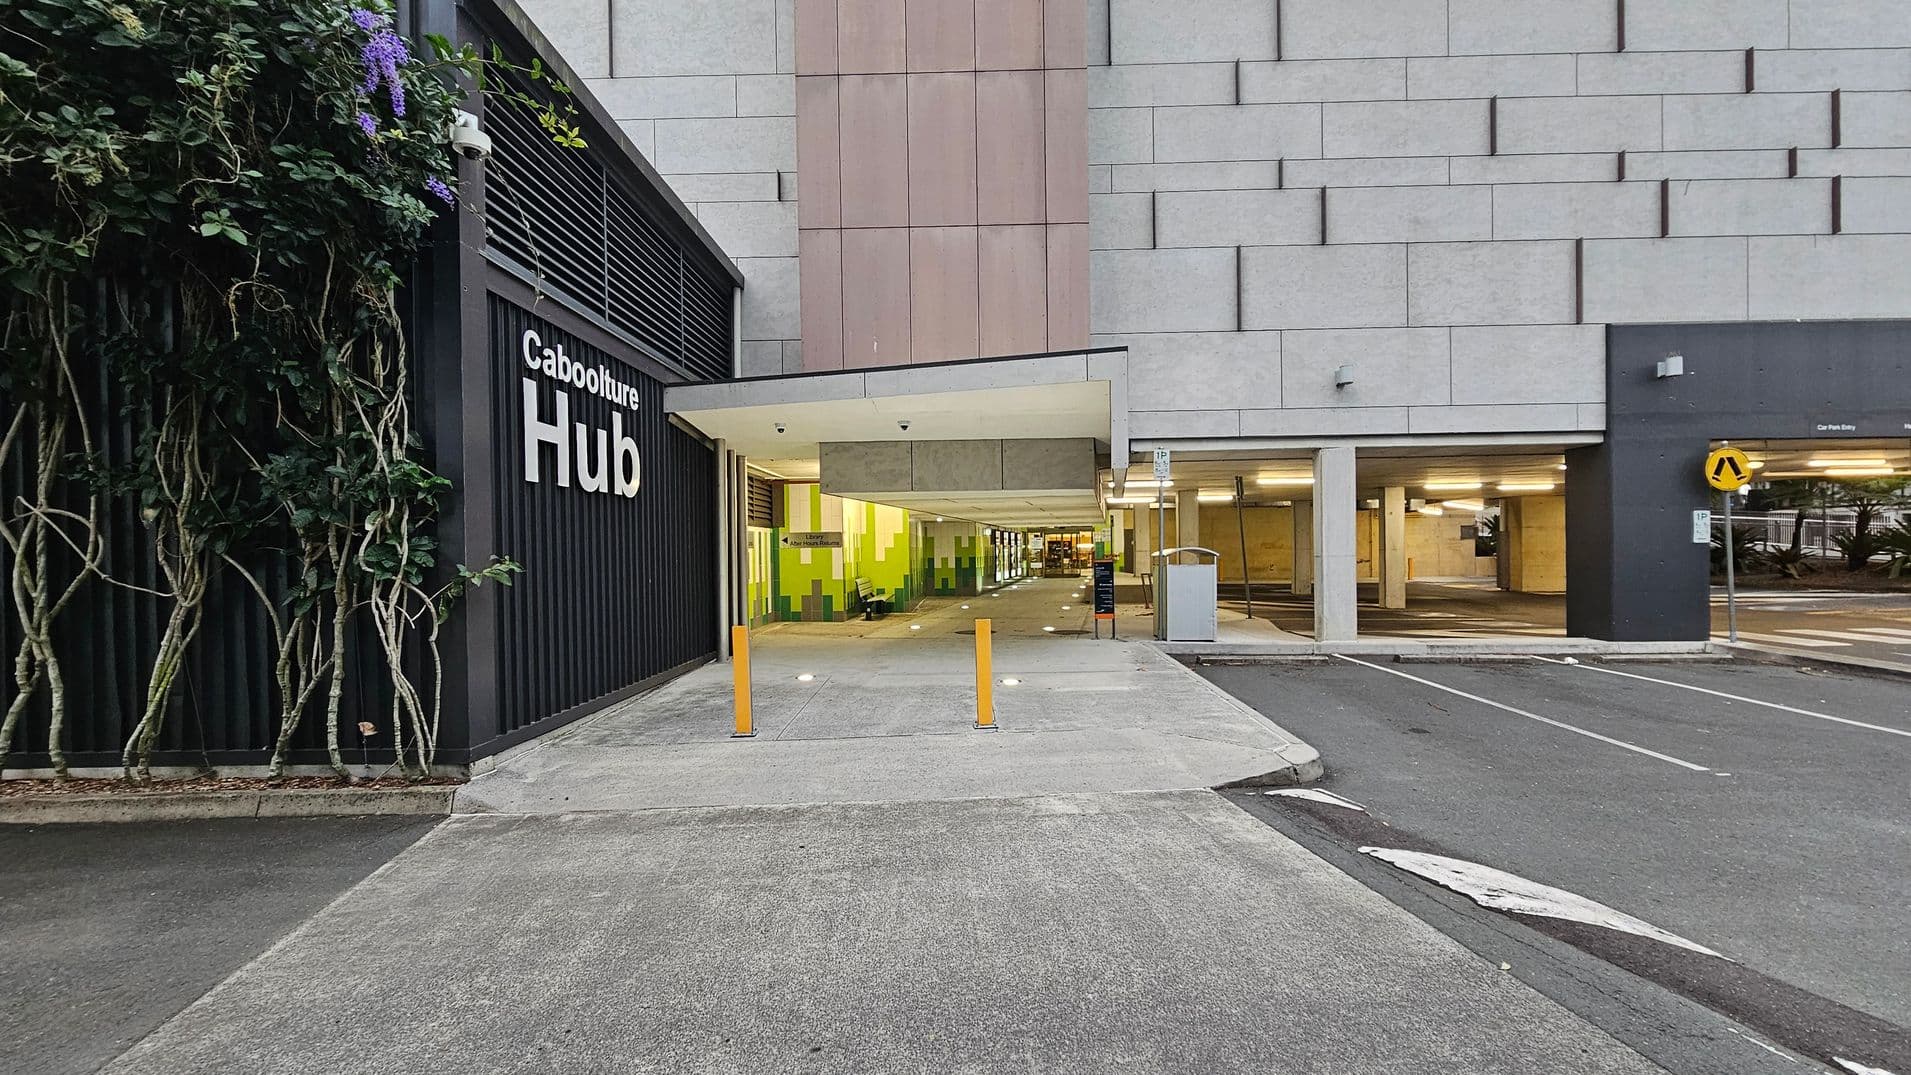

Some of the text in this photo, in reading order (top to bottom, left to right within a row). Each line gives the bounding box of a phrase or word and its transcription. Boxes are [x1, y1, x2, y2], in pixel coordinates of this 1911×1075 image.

[523, 329, 639, 411] Caboolture
[523, 377, 640, 498] Hub
[1841, 424, 1856, 432] Entry
[1156, 451, 1167, 459] 1P
